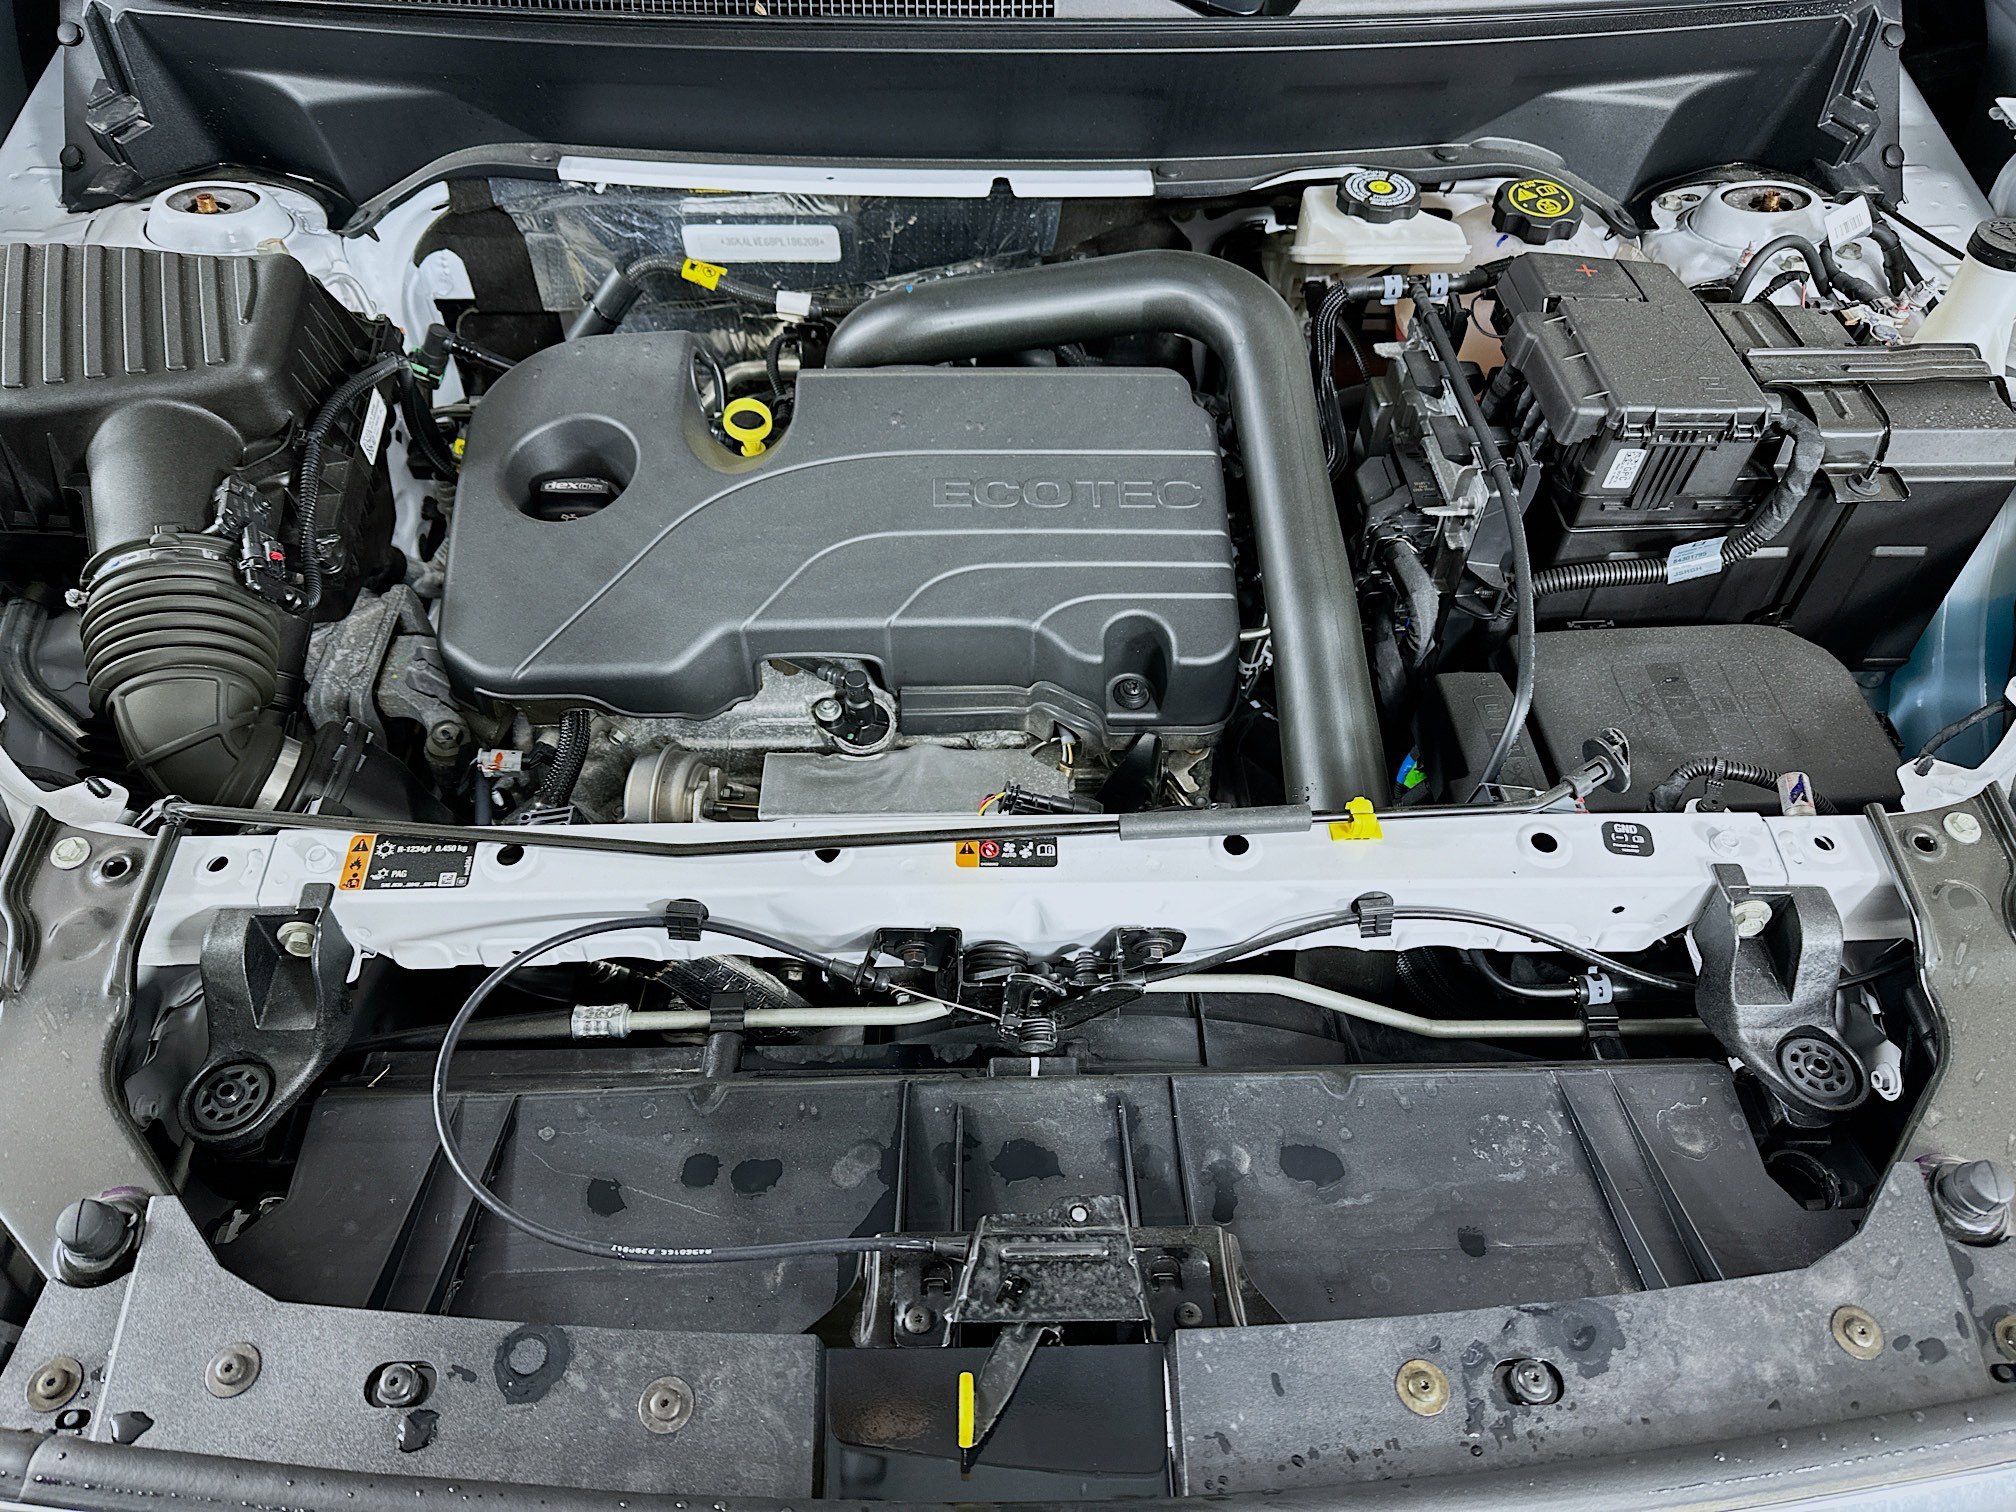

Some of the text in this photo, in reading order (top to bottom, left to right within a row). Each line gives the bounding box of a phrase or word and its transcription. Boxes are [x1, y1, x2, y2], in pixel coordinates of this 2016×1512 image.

[544, 481, 604, 491] dexos
[932, 478, 1203, 509] ECOTEC
[1613, 823, 1638, 835] GND
[396, 844, 468, 854] R-1234yf 0.450 kg
[390, 870, 408, 878] PAG
